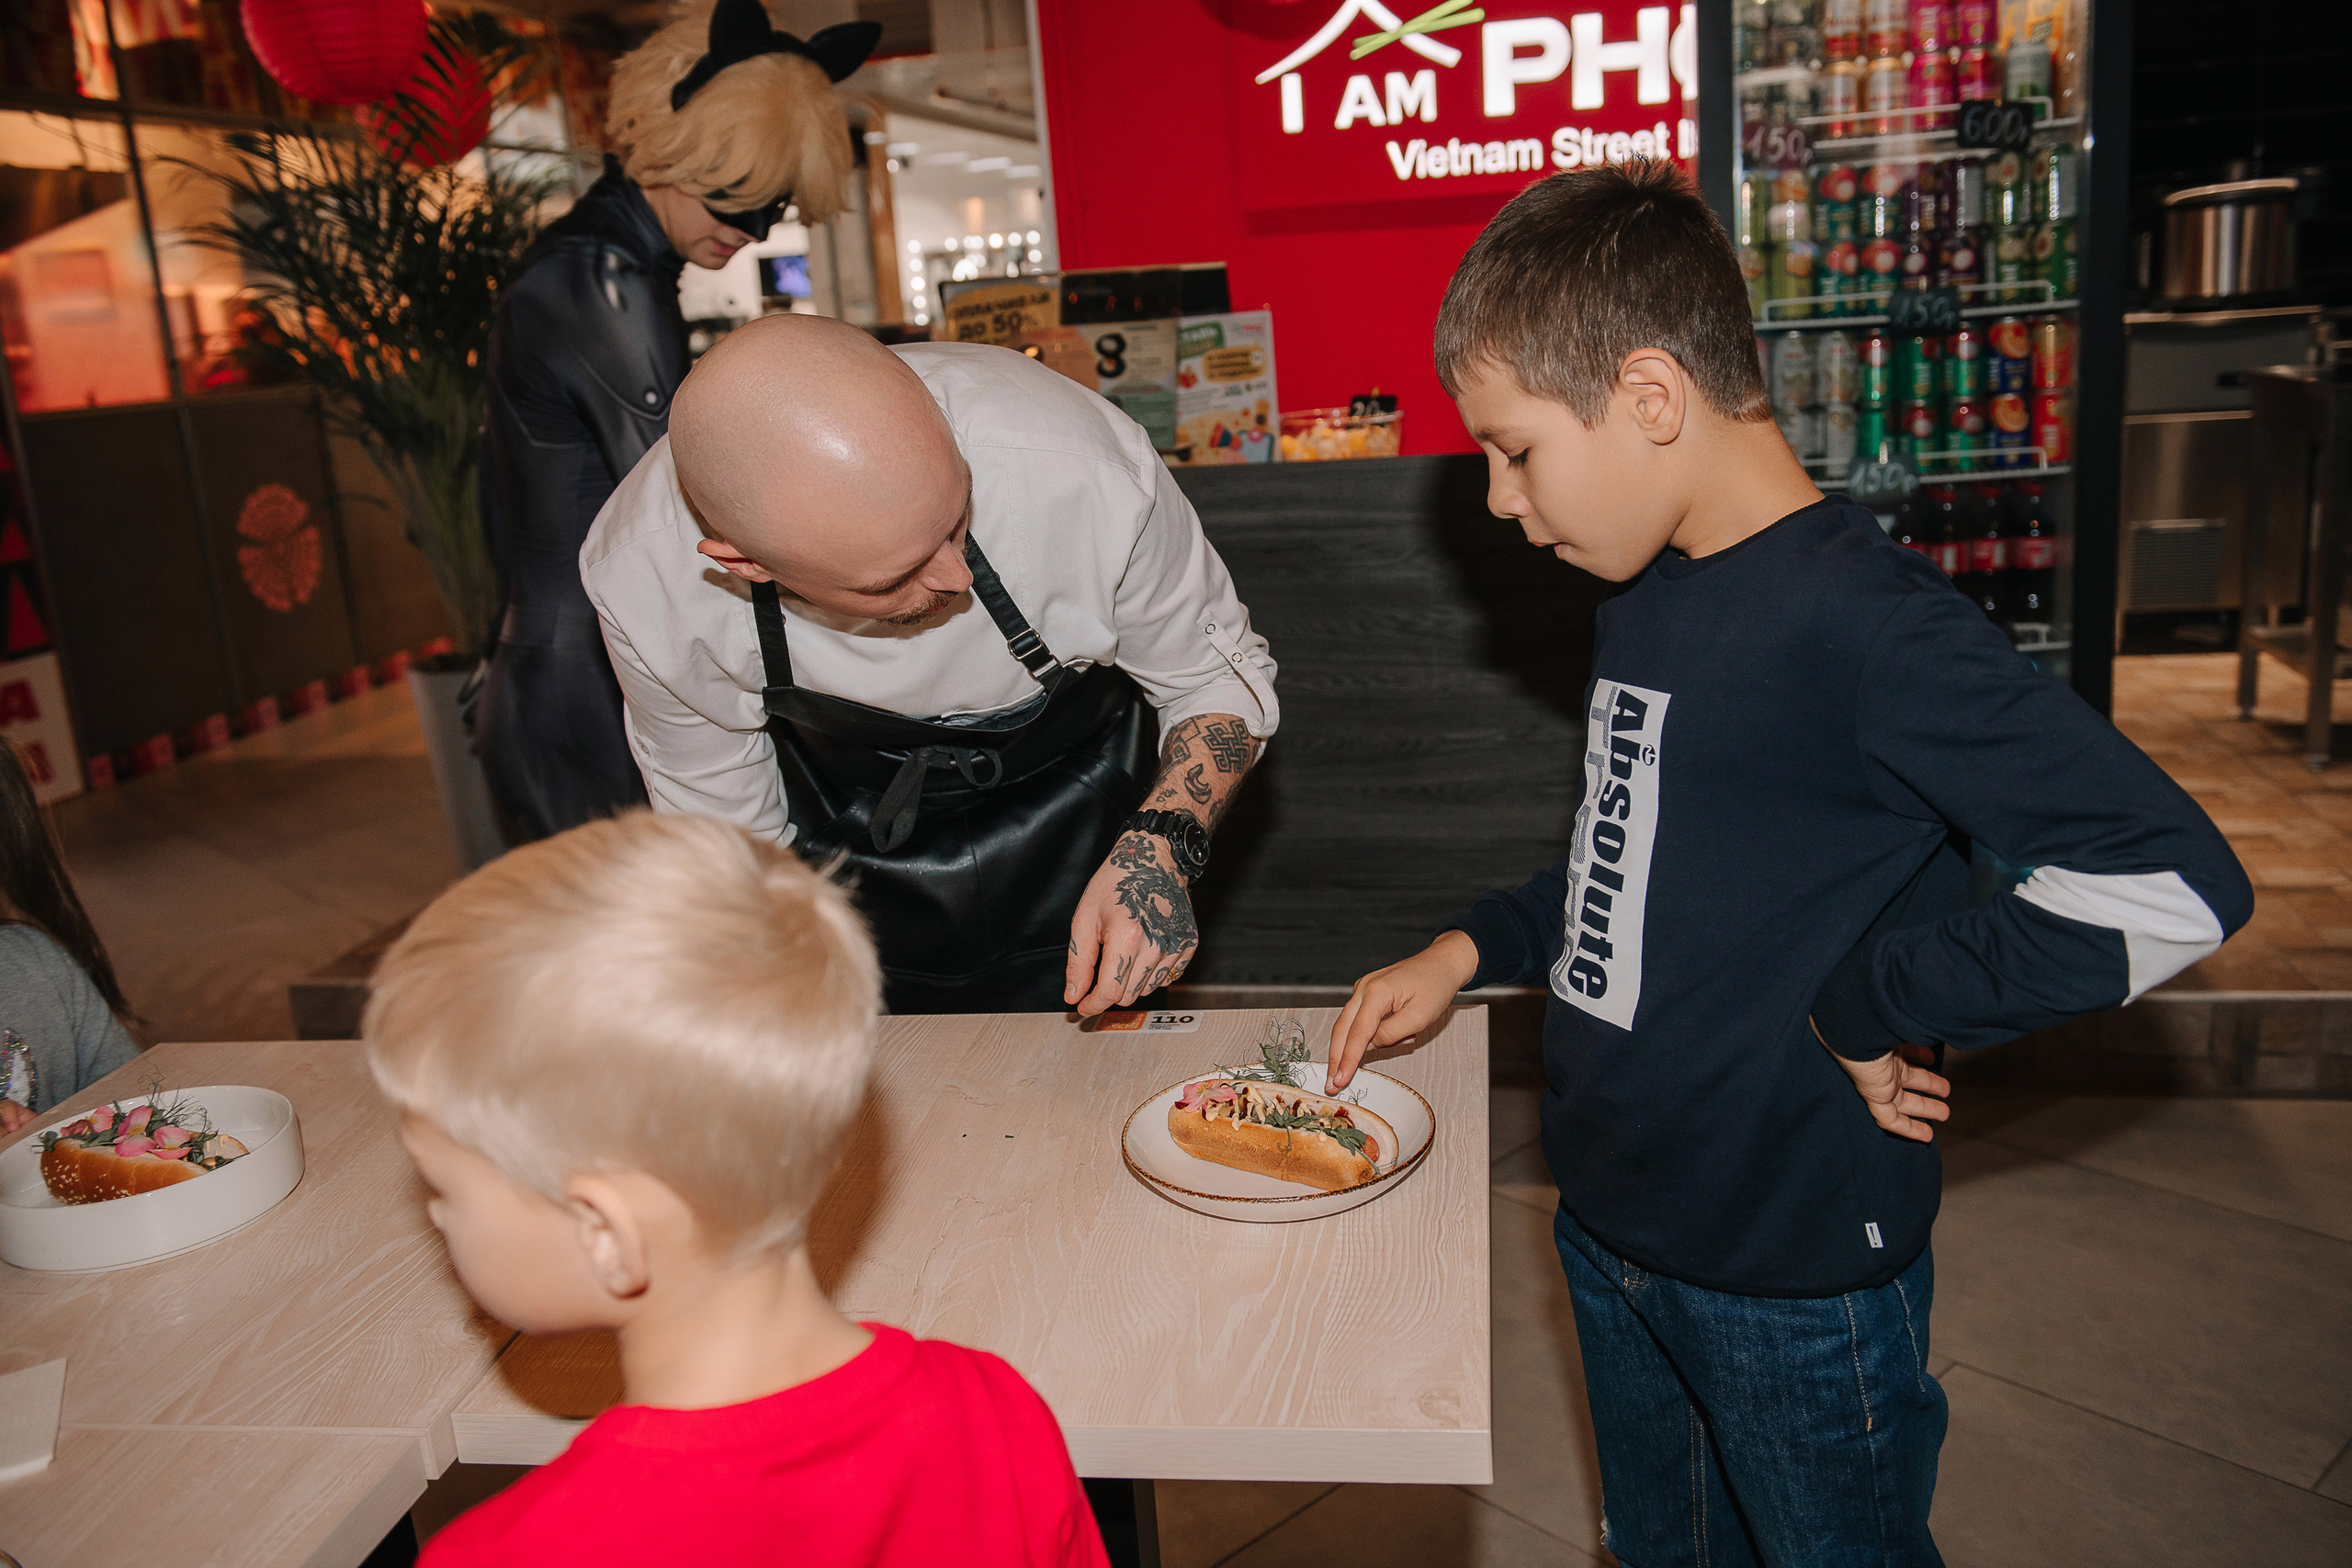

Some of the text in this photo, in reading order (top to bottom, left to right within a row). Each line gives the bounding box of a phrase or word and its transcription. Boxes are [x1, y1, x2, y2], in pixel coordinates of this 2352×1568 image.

[1280, 72, 1304, 133] I
[1334, 69, 1437, 130] AM
[1385, 137, 1544, 181] Vietnam
[1551, 121, 1671, 169] Street
[1095, 333, 1126, 378] 8
[1567, 689, 1648, 999] Absolute
[1150, 1015, 1194, 1024] 110
